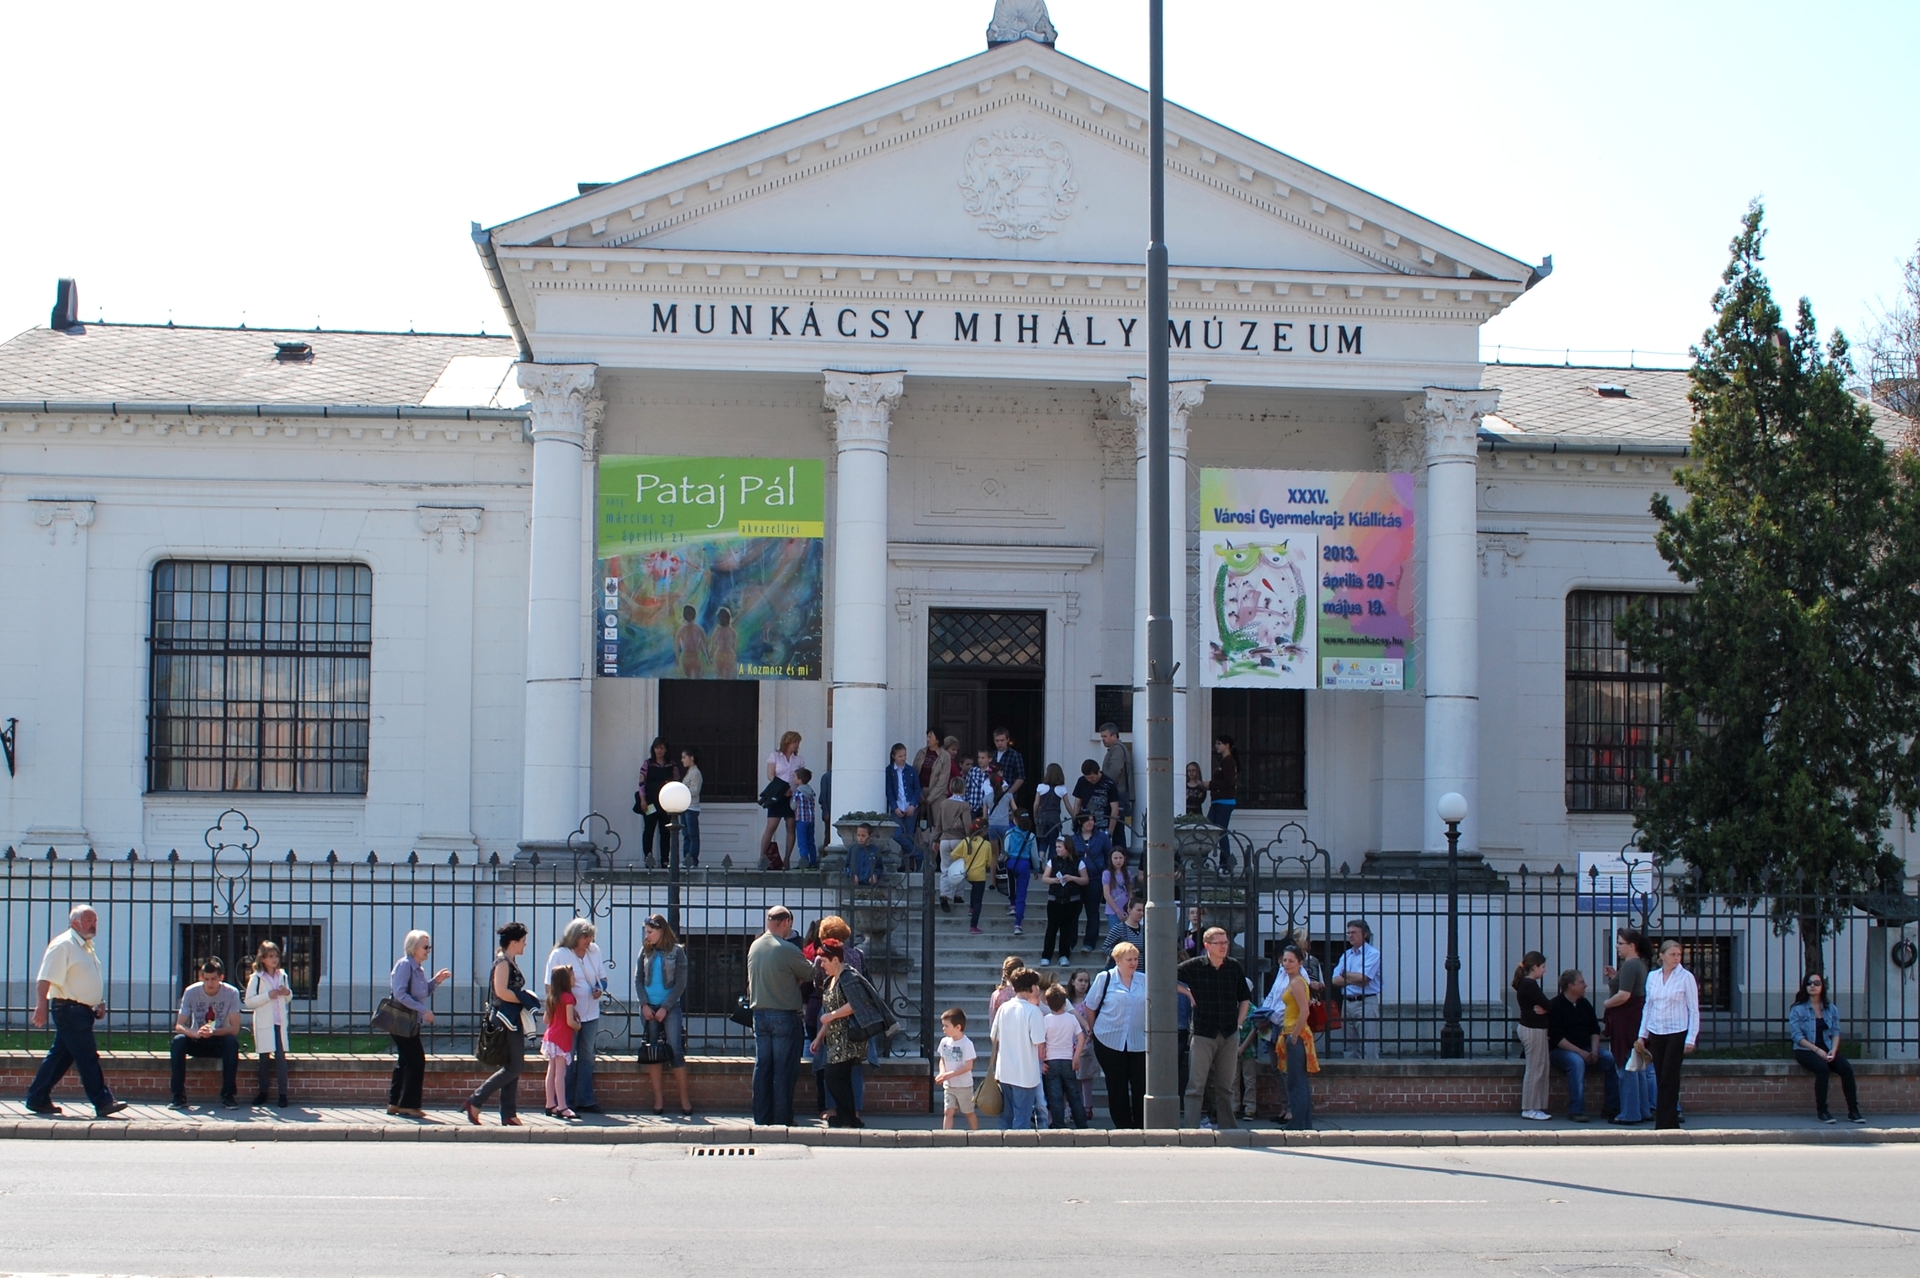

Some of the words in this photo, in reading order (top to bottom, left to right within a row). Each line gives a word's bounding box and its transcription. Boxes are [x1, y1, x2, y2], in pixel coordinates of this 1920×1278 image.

[652, 301, 925, 339] MUNKÁCSY
[954, 310, 1138, 347] MIHÁLY
[1168, 315, 1362, 355] MÚZEUM
[636, 473, 725, 529] Pataj
[739, 465, 795, 506] Pál
[1287, 488, 1329, 504] XXXV.
[606, 511, 654, 525] március
[1213, 507, 1256, 525] Városi
[1259, 508, 1345, 530] Gyermekrajz
[1348, 511, 1402, 528] Kiállítás
[621, 529, 664, 544] április
[741, 523, 800, 536] akvarelljei
[1323, 545, 1359, 562] 2013.
[1322, 572, 1363, 592] április
[1366, 573, 1384, 590] 20
[1322, 599, 1362, 619] május
[1323, 636, 1404, 649] www.munkacsy.hu
[738, 663, 745, 675] A
[747, 663, 783, 675] Kozmosz
[786, 664, 795, 676] és
[798, 664, 809, 676] mi
